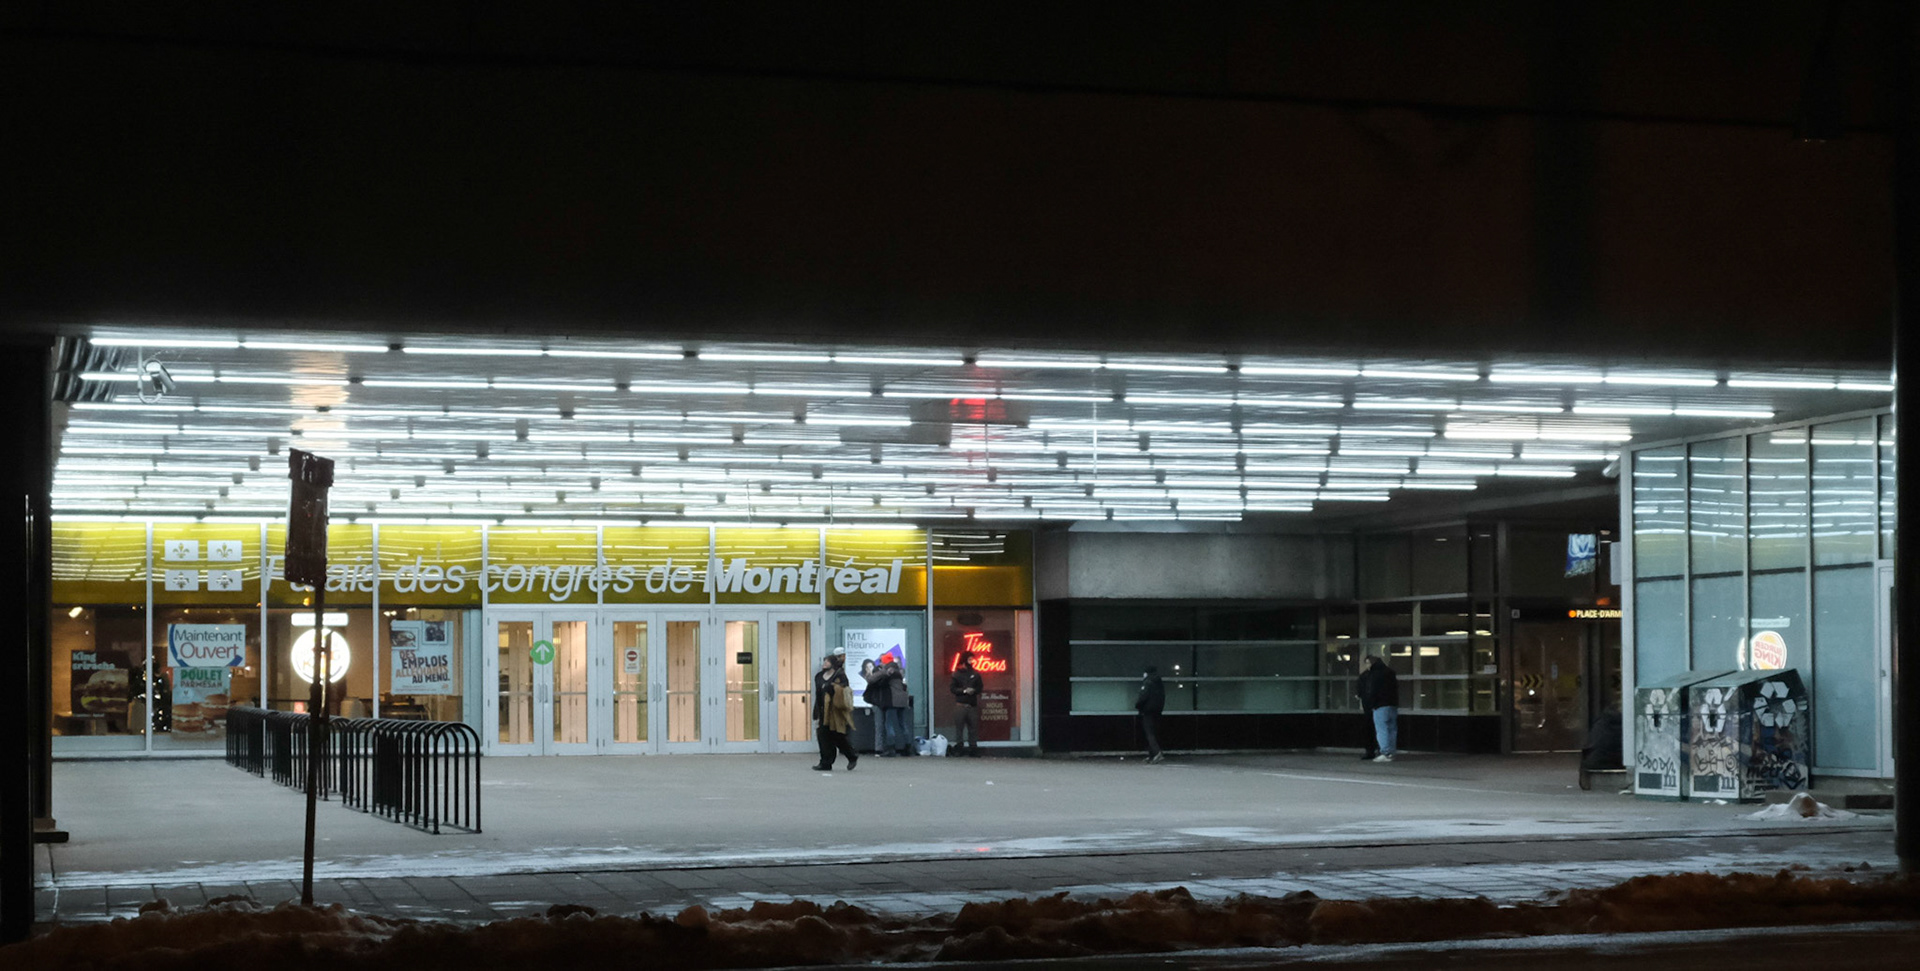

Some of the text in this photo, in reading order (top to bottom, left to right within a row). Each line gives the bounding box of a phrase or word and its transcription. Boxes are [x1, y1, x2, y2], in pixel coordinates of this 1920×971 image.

[266, 555, 903, 602] Pais des congrès de Montréal
[175, 630, 242, 642] Maintenant
[847, 632, 867, 640] MTL
[964, 632, 992, 652] Tim
[180, 642, 239, 659] Ouvert
[400, 650, 416, 660] DES
[72, 651, 97, 663] King
[402, 655, 448, 669] EMPLOIS
[181, 669, 222, 680] POULET
[412, 674, 423, 684] AU
